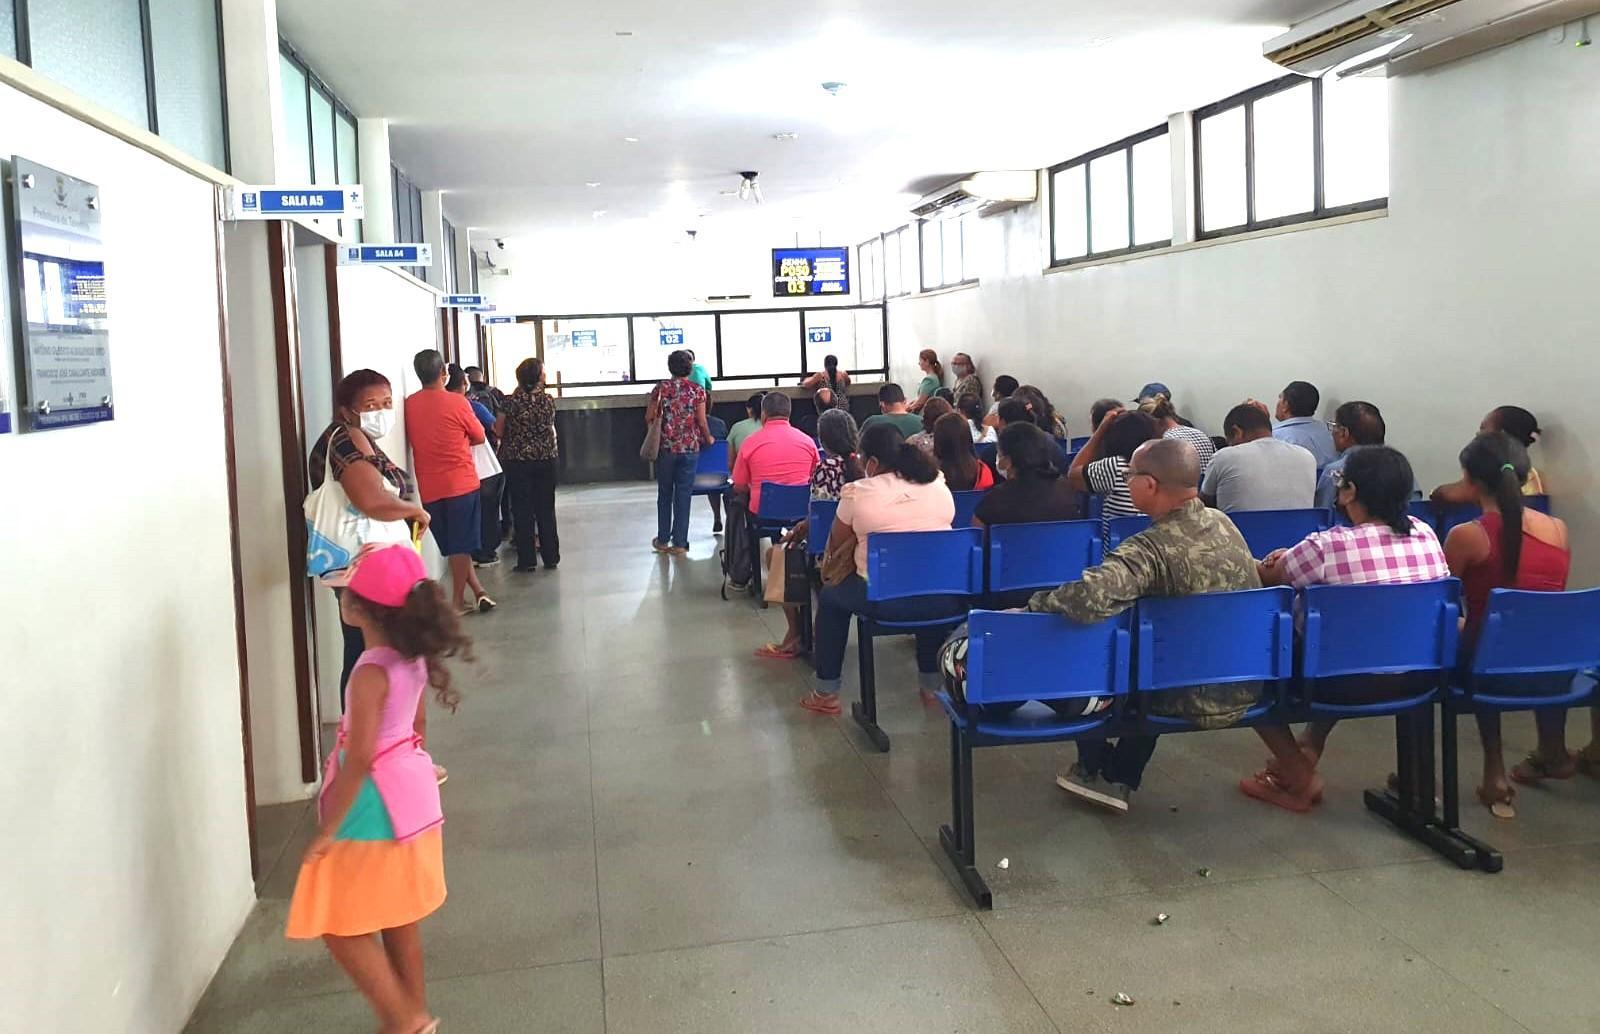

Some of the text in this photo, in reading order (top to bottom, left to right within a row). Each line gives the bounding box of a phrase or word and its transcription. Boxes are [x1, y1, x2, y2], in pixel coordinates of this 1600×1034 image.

[281, 195, 324, 206] SALA A5
[375, 249, 393, 257] SALA
